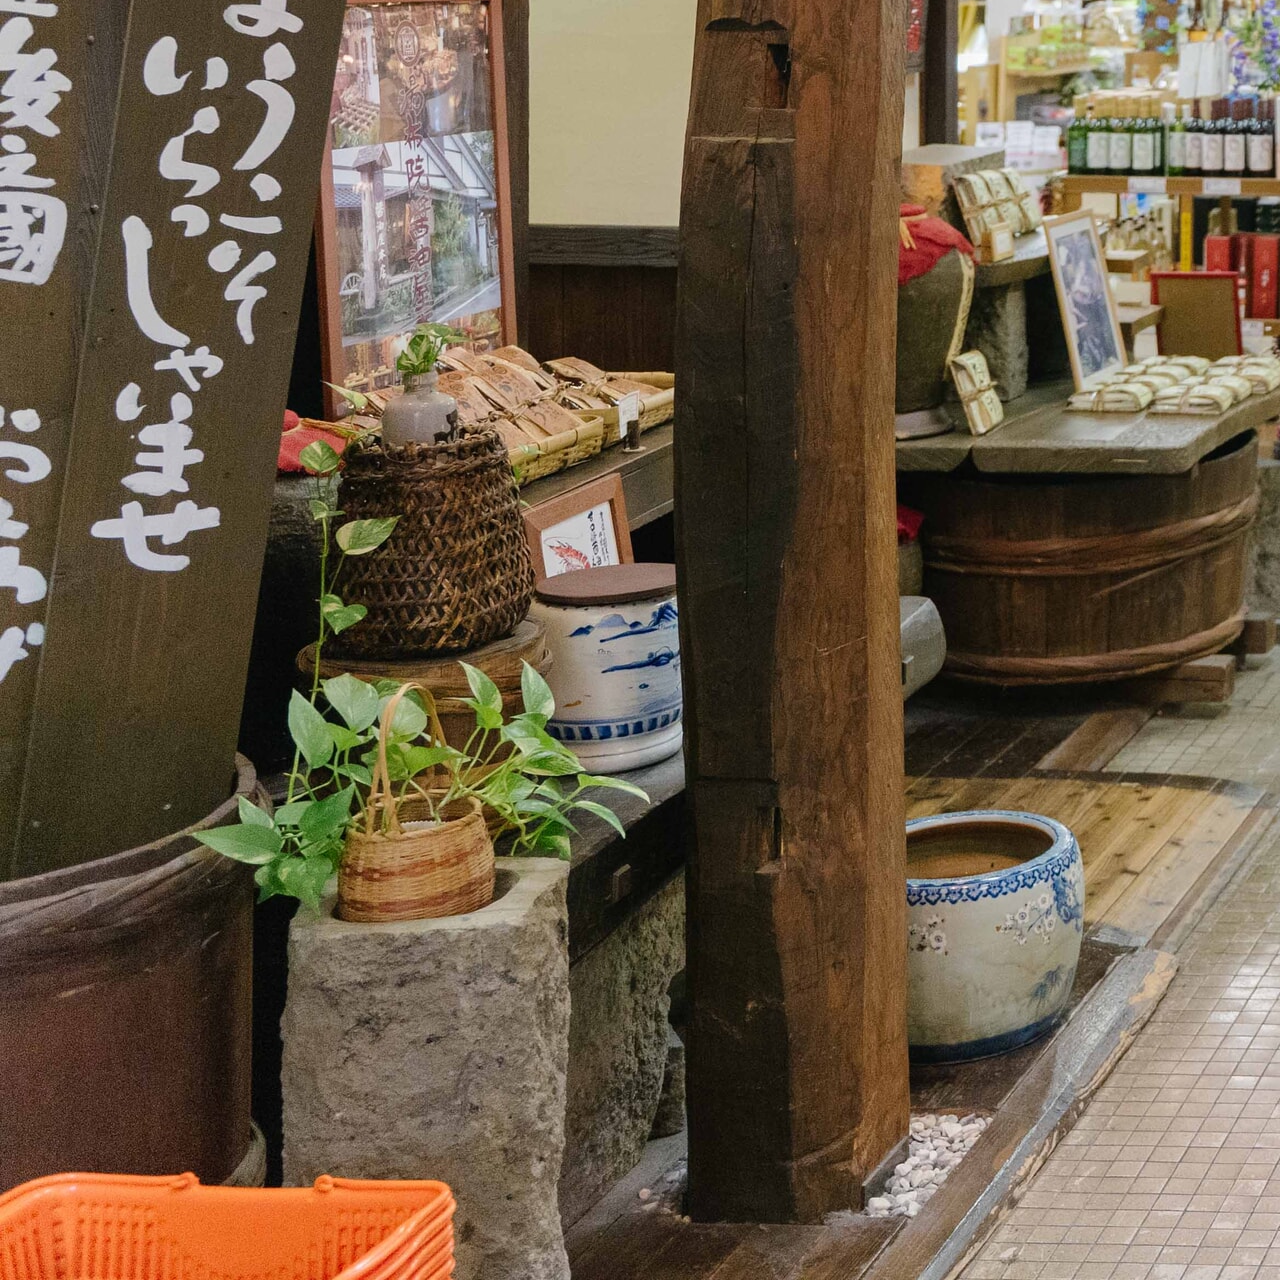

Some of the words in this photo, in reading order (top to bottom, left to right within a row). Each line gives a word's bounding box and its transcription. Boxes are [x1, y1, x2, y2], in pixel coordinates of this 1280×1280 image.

[91, 34, 230, 572] いらっしゃいませ
